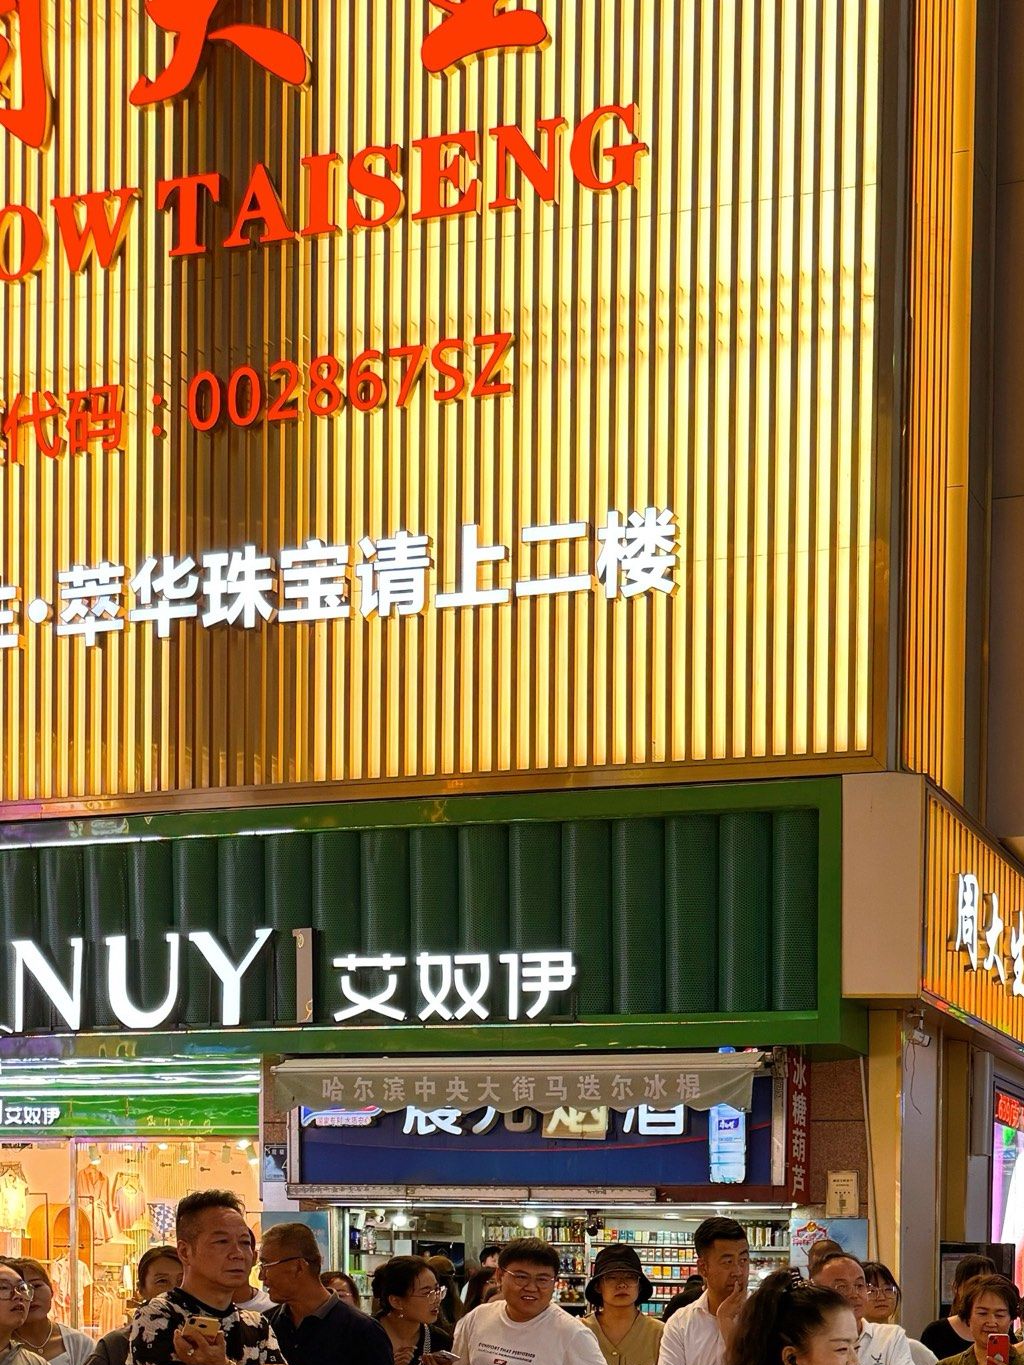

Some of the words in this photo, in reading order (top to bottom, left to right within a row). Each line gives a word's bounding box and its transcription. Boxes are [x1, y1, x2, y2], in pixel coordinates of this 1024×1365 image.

[157, 103, 646, 258] TAISENG
[0, 506, 677, 648] ·萃华珠宝请上二楼
[0, 928, 274, 1034] NUY
[333, 951, 577, 1023] 艾奴伊
[4, 1105, 61, 1126] 艾奴伊
[321, 1073, 702, 1102] 哈尔滨中央大街马迭尔冰棍
[792, 1056, 807, 1197] 冰糖葫芦
